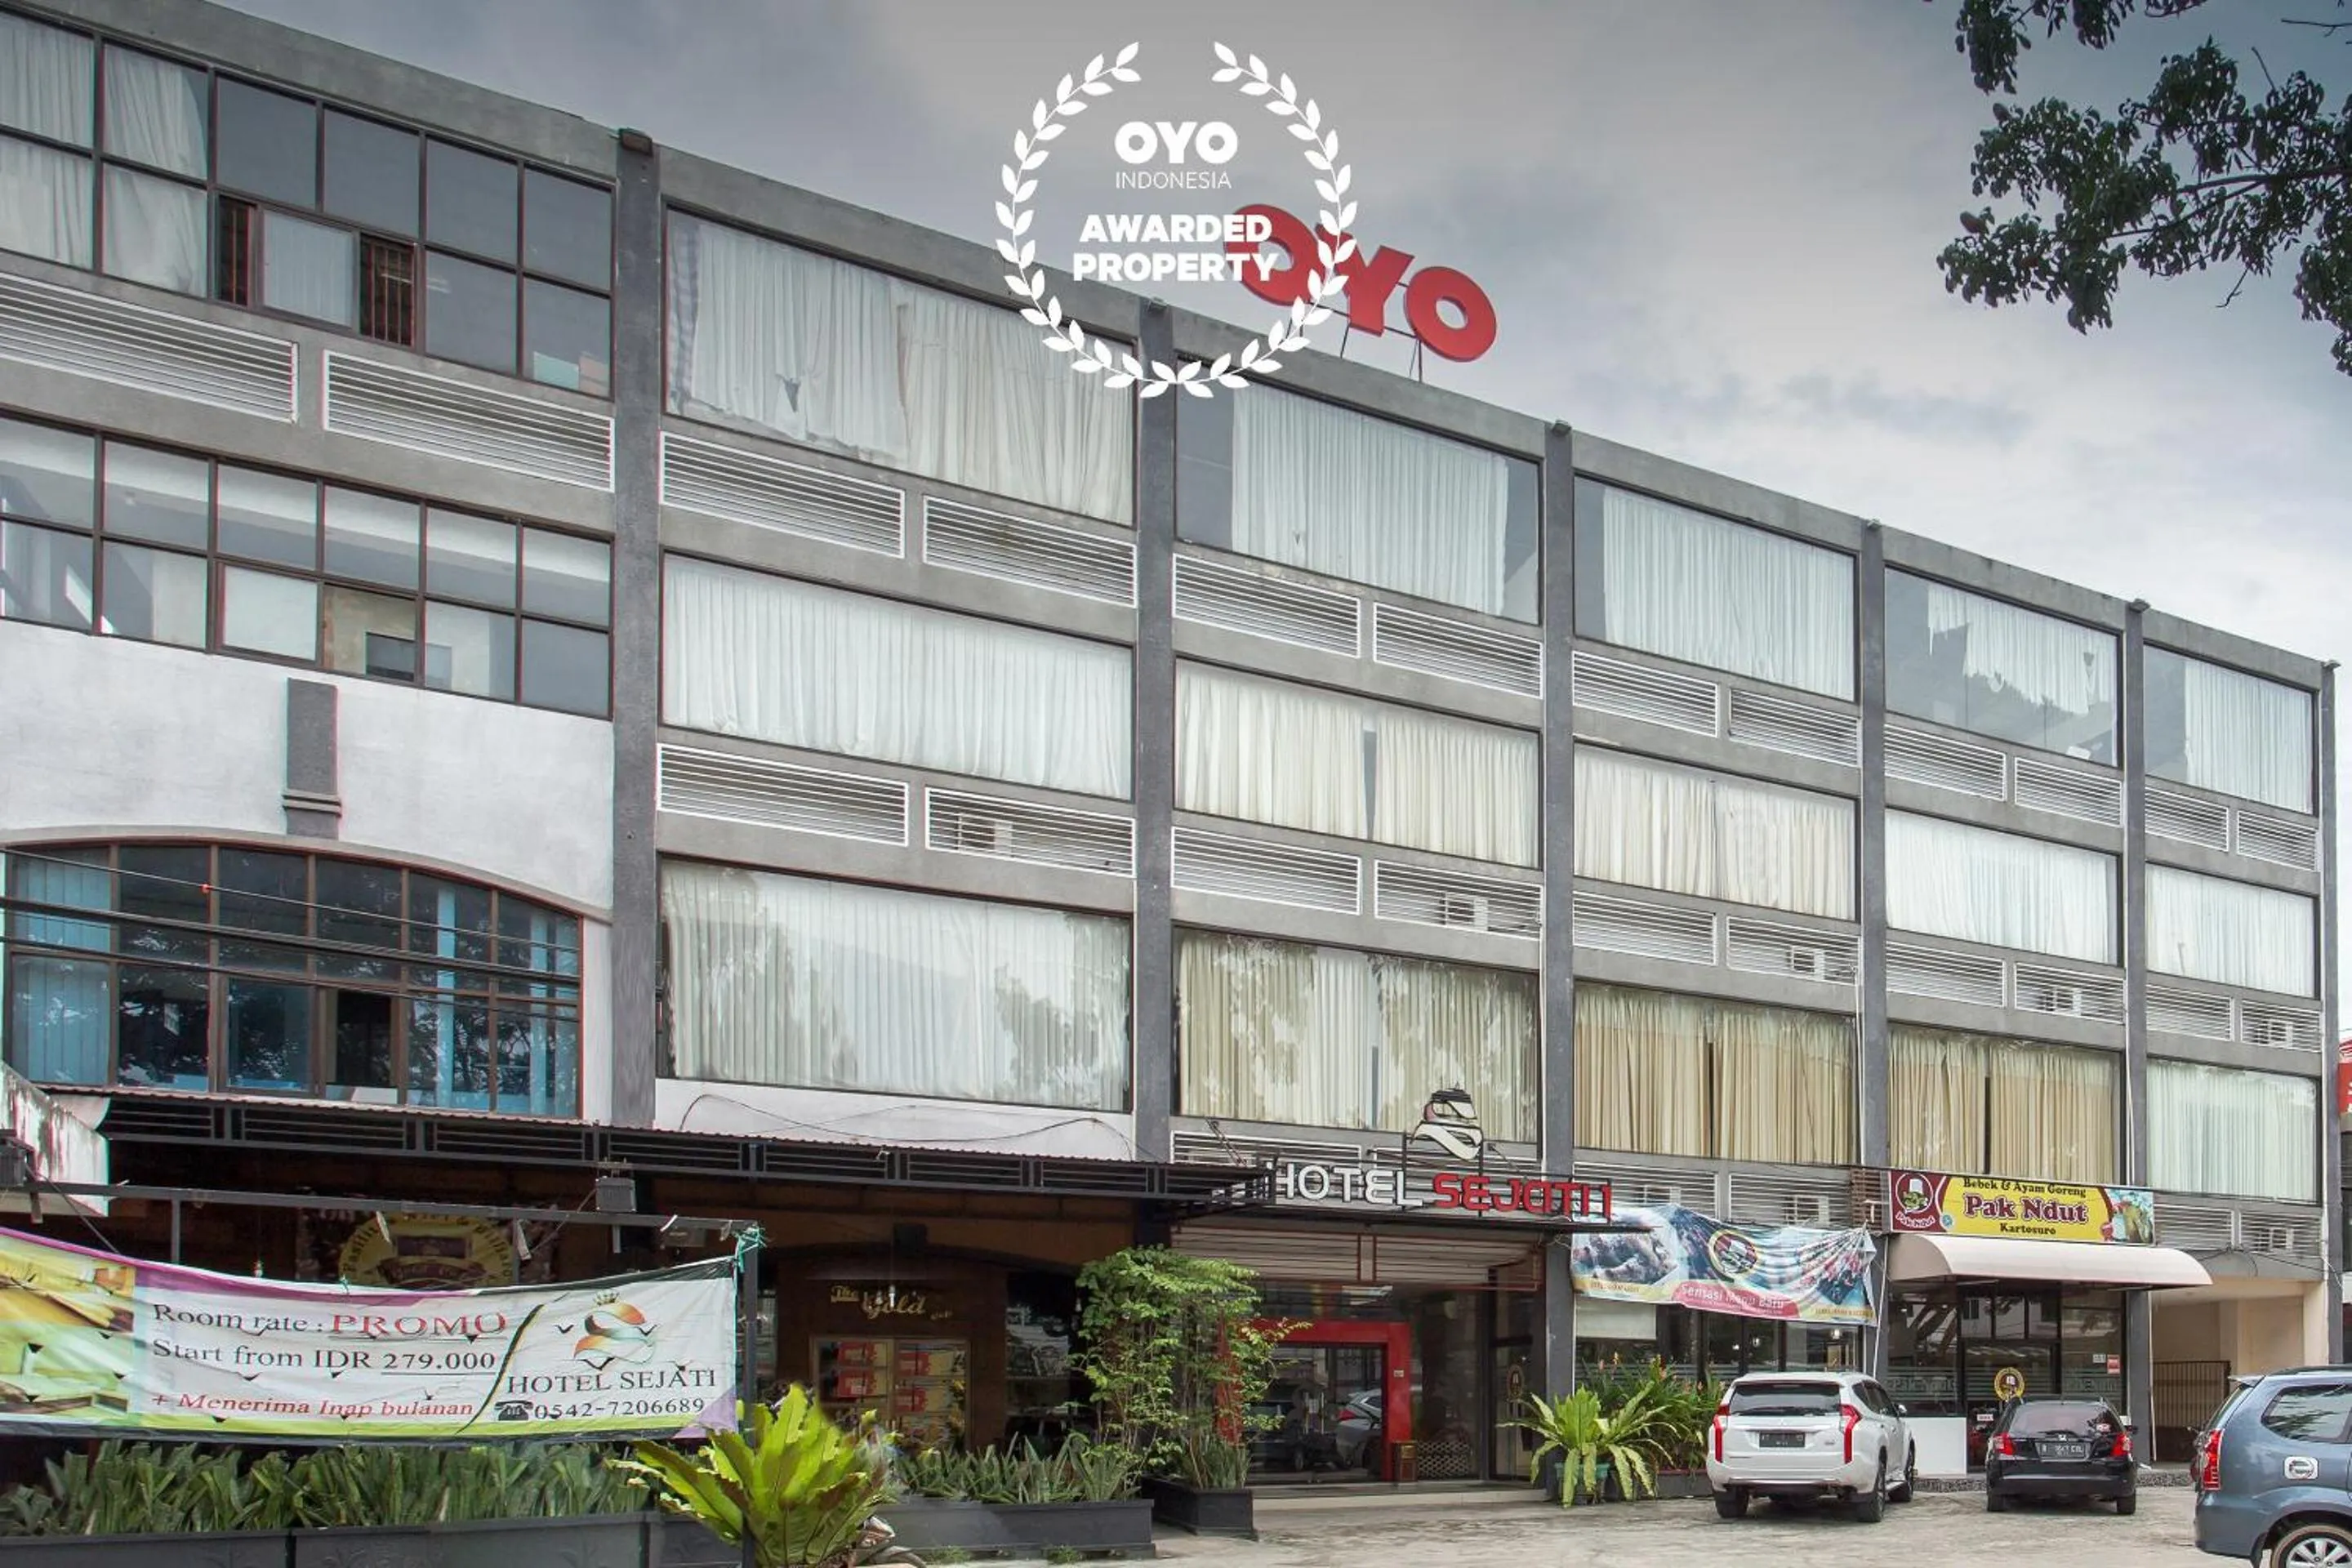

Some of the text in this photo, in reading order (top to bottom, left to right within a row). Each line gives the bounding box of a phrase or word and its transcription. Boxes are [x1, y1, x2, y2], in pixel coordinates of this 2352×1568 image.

[1224, 203, 1497, 363] OYO
[1268, 1161, 1423, 1206] HOTEL
[1963, 1178, 1998, 1190] Bebek
[2014, 1182, 2045, 1194] Ayam
[2047, 1185, 2087, 1198] Goreng
[1964, 1194, 2088, 1223] Pak Ndut
[154, 1303, 243, 1330] Room
[254, 1316, 308, 1332] rate
[331, 1312, 509, 1336] PROMO
[153, 1339, 496, 1370] Start from IDR 279.000
[508, 1369, 716, 1393] HOTEL SEJATI
[177, 1393, 311, 1414] Menerima
[319, 1400, 373, 1419] Inap
[381, 1401, 474, 1416] bulanan
